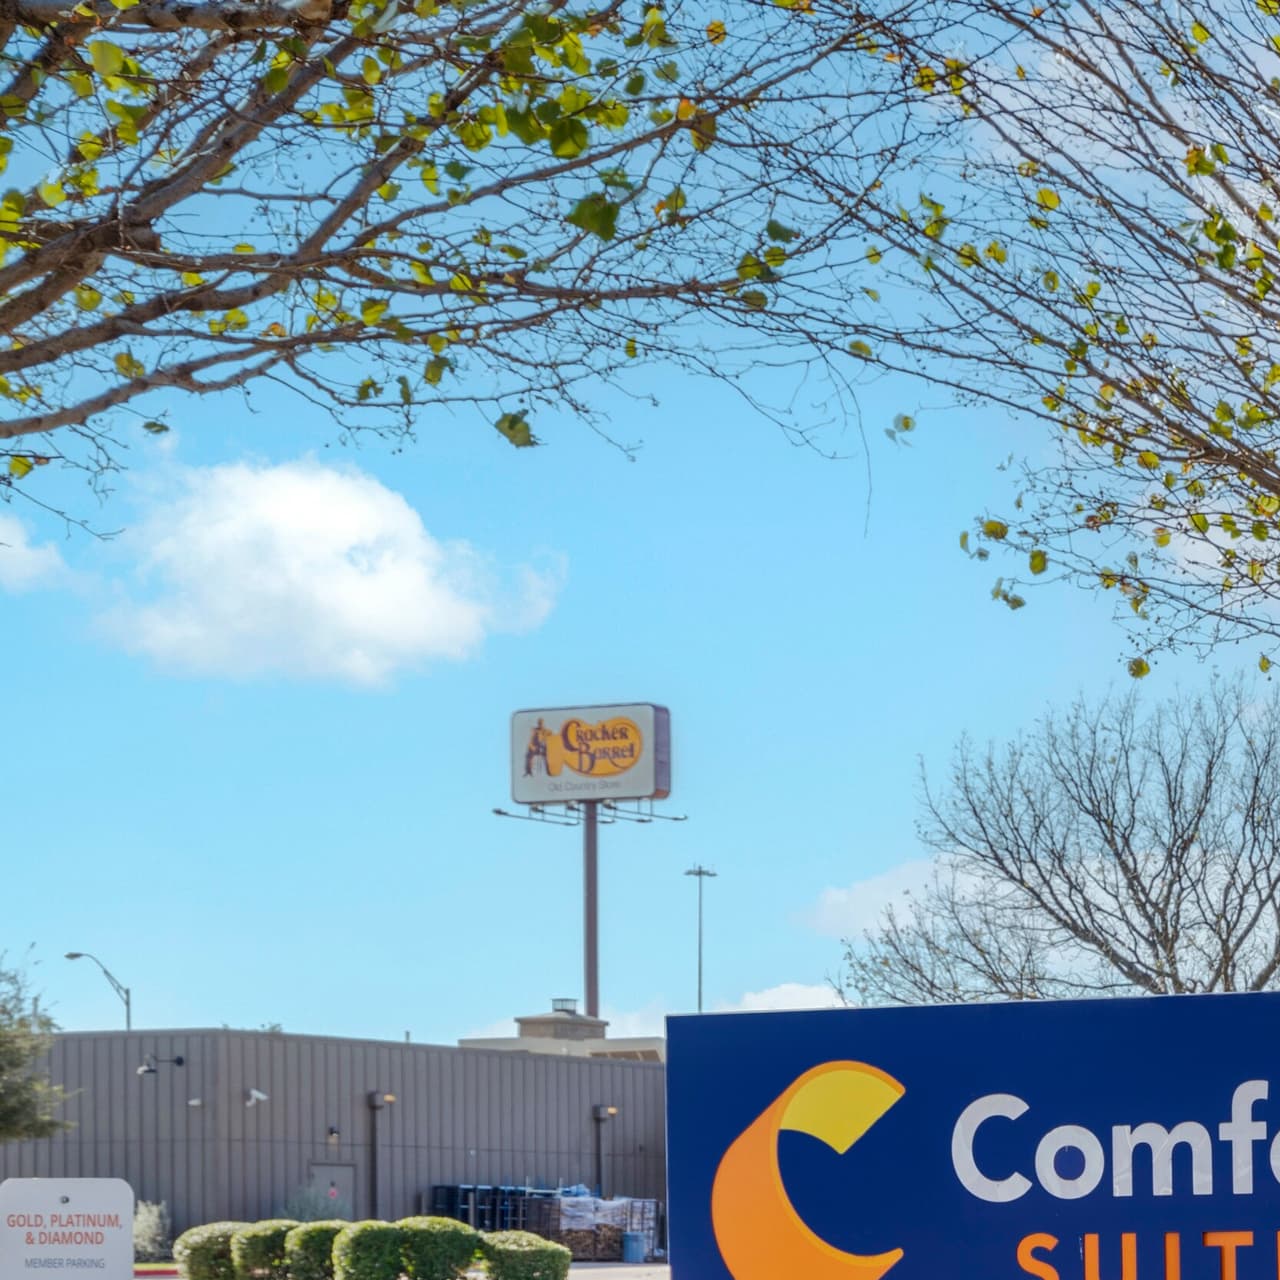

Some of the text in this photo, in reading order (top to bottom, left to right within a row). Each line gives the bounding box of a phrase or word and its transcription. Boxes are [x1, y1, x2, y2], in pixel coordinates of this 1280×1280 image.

[7, 1214, 123, 1229] GOLD, PLATINUM,
[25, 1231, 105, 1245] & DIAMOND
[25, 1258, 105, 1269] MEMBER PARKING
